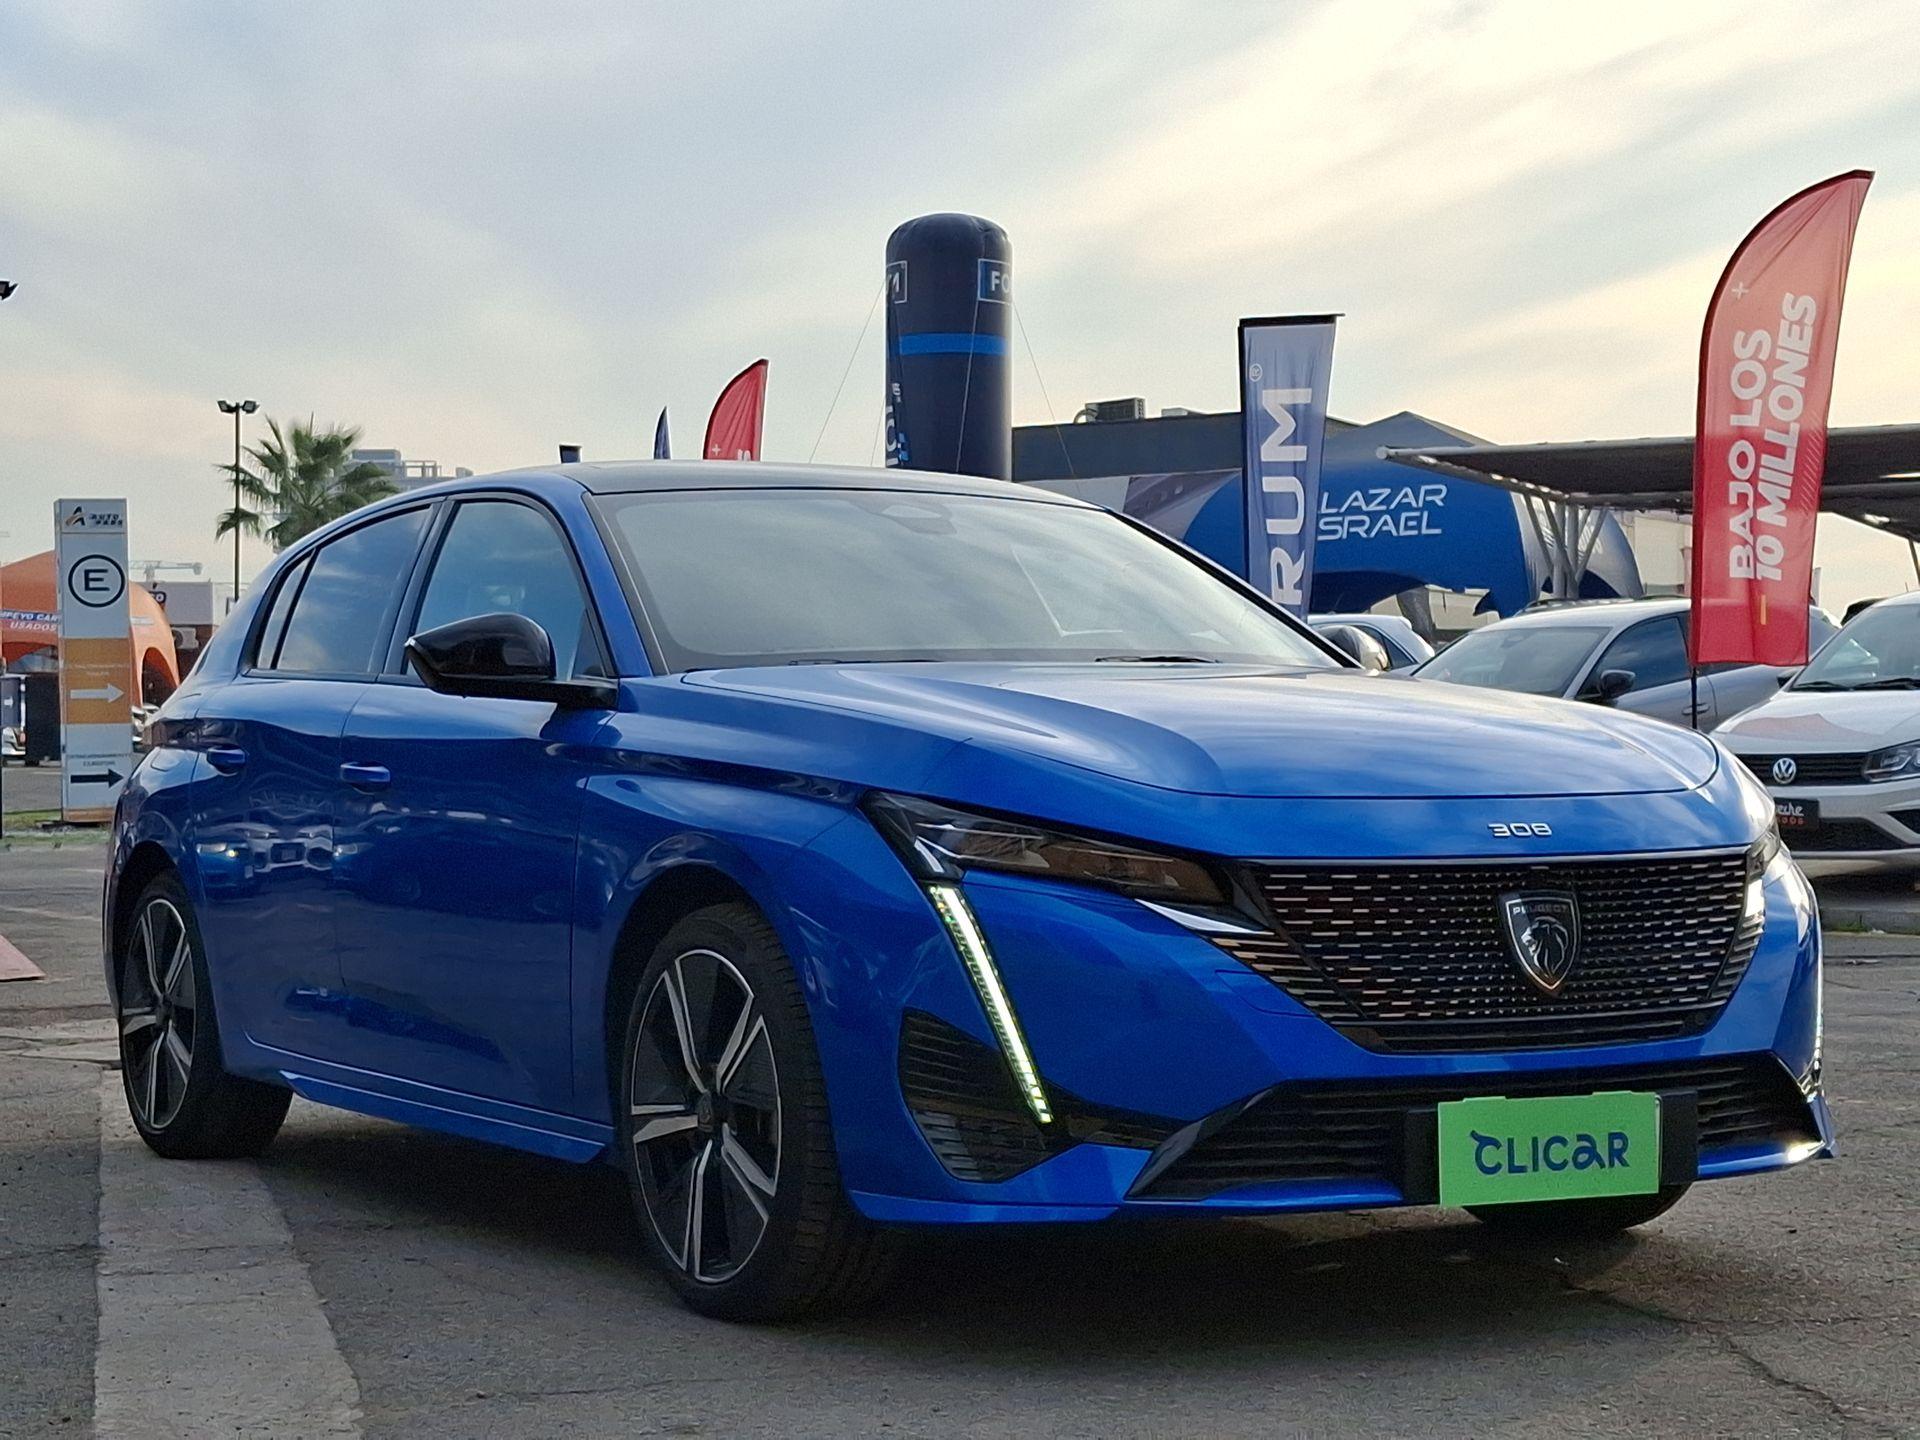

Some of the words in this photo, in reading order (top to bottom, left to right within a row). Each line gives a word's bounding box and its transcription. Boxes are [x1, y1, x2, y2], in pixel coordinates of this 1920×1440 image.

[1729, 328, 1772, 427] LOS
[1756, 292, 1817, 528] MILLONES
[1260, 387, 1313, 606] RUM
[1320, 483, 1448, 514] LAZAR
[1728, 439, 1756, 580] BAJO
[1316, 511, 1443, 541] SRAEL
[1755, 534, 1785, 582] 10
[83, 568, 110, 592] E
[10, 621, 58, 632] USADOS
[1488, 822, 1553, 838] 308
[1512, 903, 1571, 916] PEUGEOT
